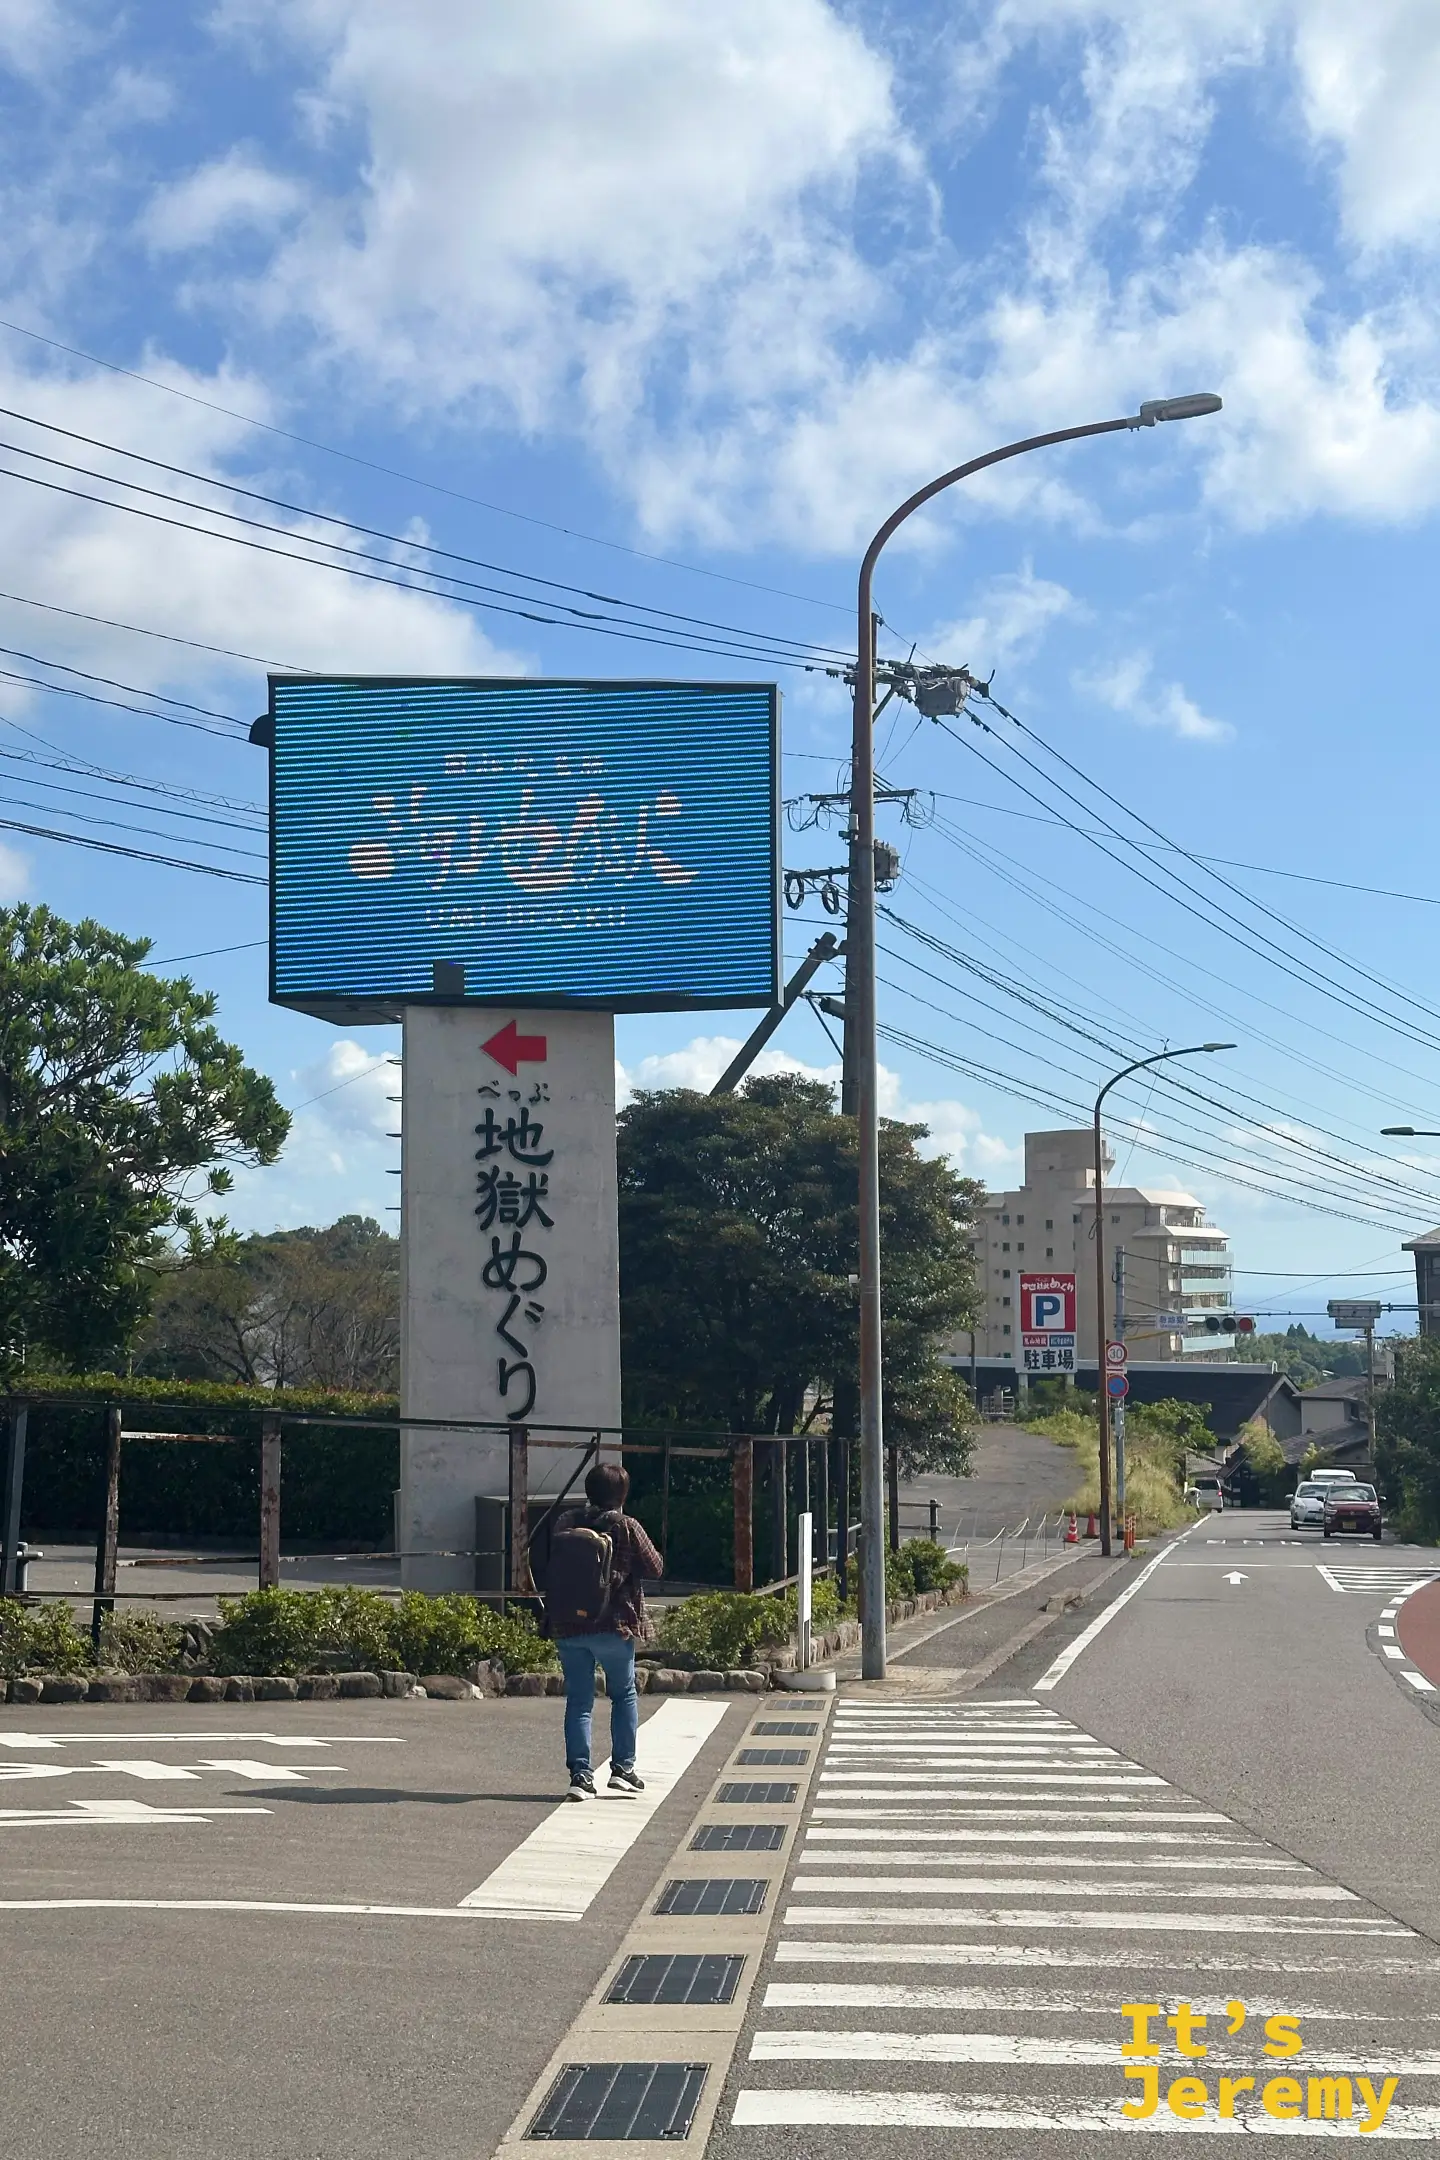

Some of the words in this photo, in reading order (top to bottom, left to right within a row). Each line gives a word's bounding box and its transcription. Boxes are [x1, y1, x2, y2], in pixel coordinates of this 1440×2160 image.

[475, 1106, 554, 1421] 地獄めぐり
[1036, 1296, 1060, 1326] P
[1024, 1349, 1074, 1370] 駐車場
[1109, 1348, 1123, 1359] 30
